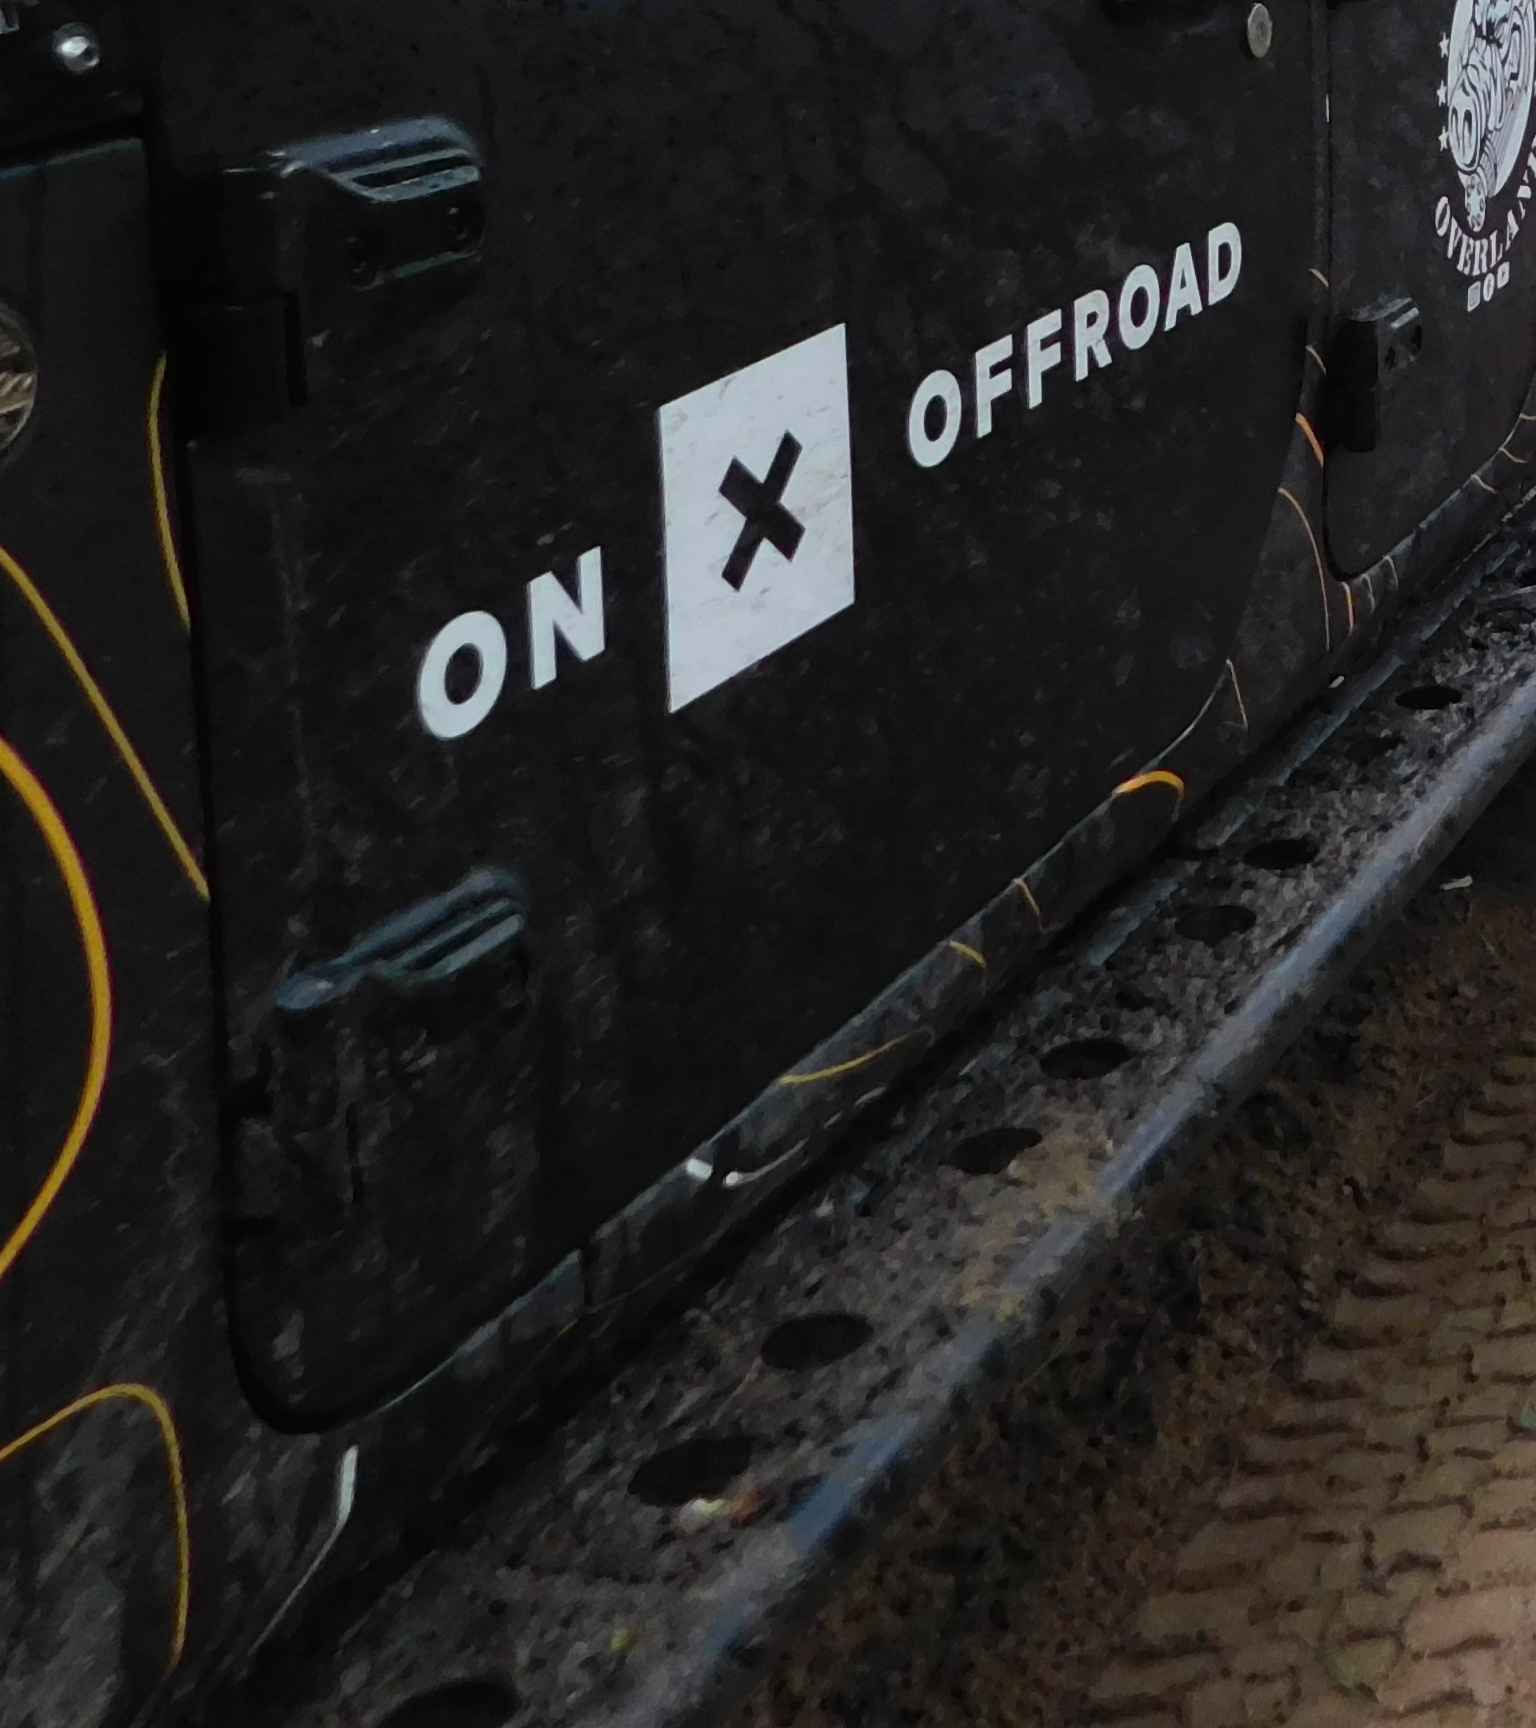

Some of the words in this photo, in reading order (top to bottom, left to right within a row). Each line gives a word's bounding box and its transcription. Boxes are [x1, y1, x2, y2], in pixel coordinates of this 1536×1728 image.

[417, 544, 606, 739] ON
[718, 429, 805, 592] X
[907, 221, 1243, 468] OFFROAD
